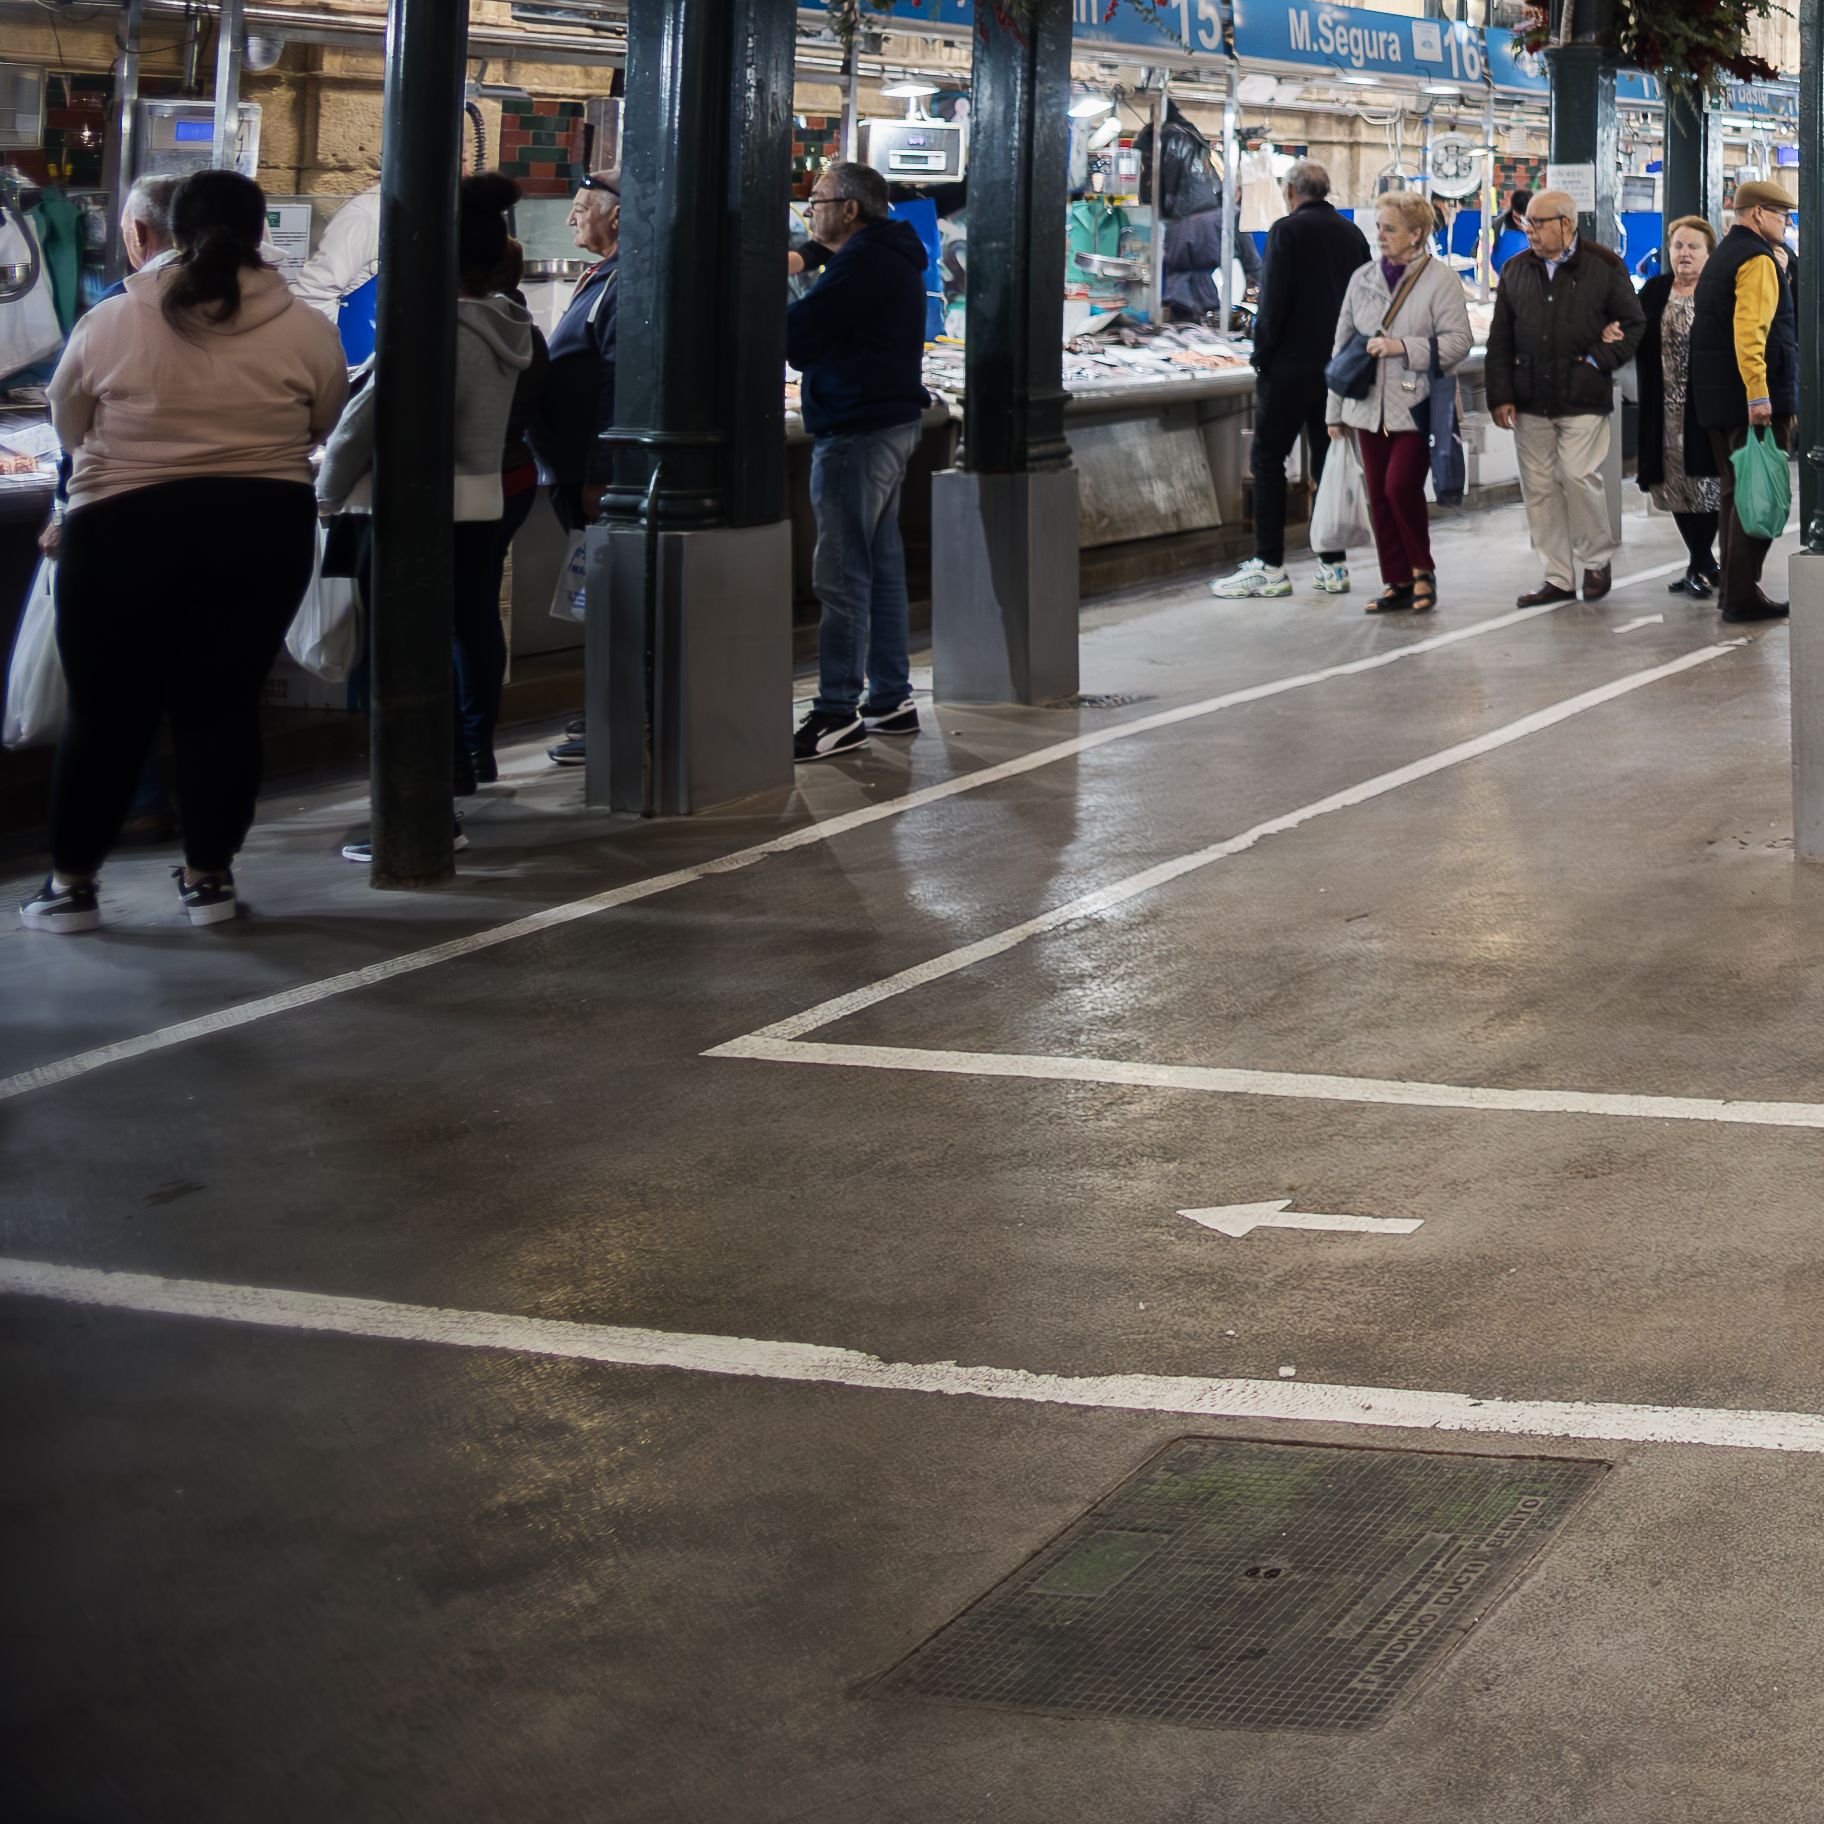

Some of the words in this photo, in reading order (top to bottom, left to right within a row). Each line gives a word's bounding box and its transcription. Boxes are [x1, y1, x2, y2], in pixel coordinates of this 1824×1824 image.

[1288, 7, 1402, 68] M.Segura
[1443, 23, 1481, 81] 16
[1358, 1613, 1439, 1684] FUNDICIO
[1433, 1560, 1490, 1606] DUCTI
[1485, 1497, 1541, 1548] BENITO
